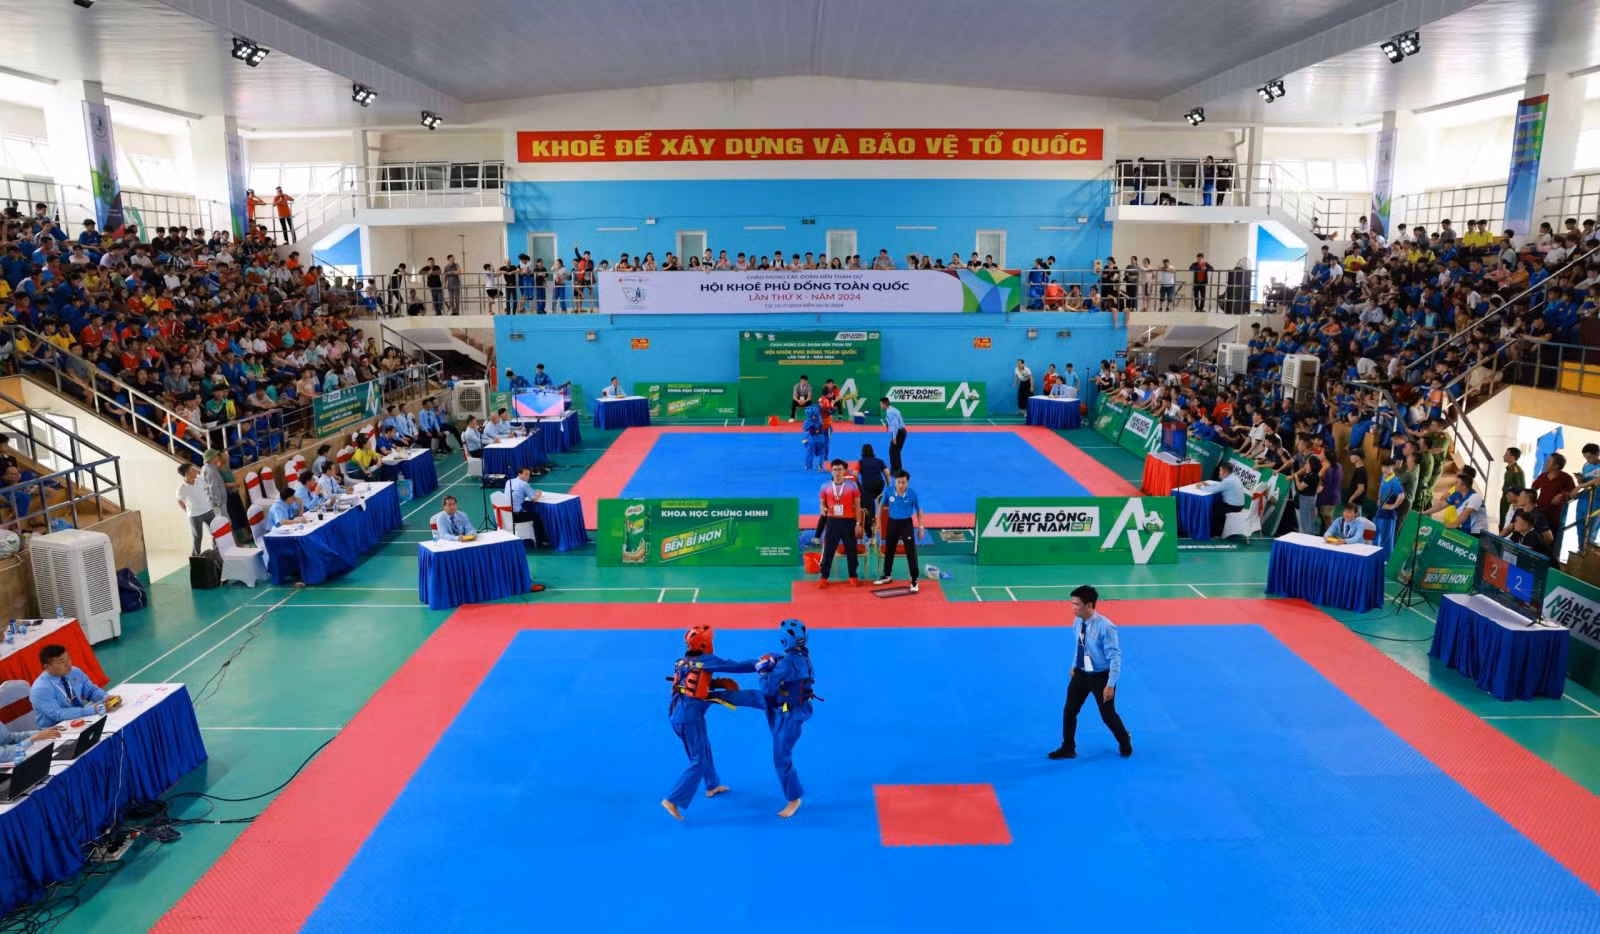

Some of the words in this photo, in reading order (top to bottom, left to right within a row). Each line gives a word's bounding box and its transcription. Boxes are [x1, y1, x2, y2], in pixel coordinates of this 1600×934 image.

[532, 134, 605, 157] KHOẺ
[614, 132, 652, 156] ĐỂ
[660, 135, 716, 156] XÂY
[725, 137, 804, 158] DỰNG
[813, 133, 849, 155] VÀ
[859, 132, 915, 155] BẢO
[925, 134, 959, 157] VỆ
[968, 131, 1004, 155] TỔ
[1012, 132, 1087, 156] QUỐC
[700, 281, 723, 293] HỘI
[764, 281, 790, 291] PHÙ
[793, 280, 831, 291] ĐỔNG
[834, 280, 869, 291] TOÀN
[872, 280, 910, 291] QUỐC
[771, 292, 793, 300] THỨ
[811, 292, 835, 300] NĂM
[690, 510, 709, 518] HỌC
[711, 508, 742, 517] CHỨNG
[995, 510, 1041, 527] NĂNG
[1002, 520, 1035, 534] VIỆT
[1037, 522, 1070, 532] NAM
[1438, 538, 1454, 551] KHOA
[1454, 546, 1469, 558] HỌC
[1490, 564, 1498, 579] 2
[1515, 575, 1523, 591] 2
[1545, 594, 1593, 620] NĂNG
[1579, 621, 1600, 640] NA
